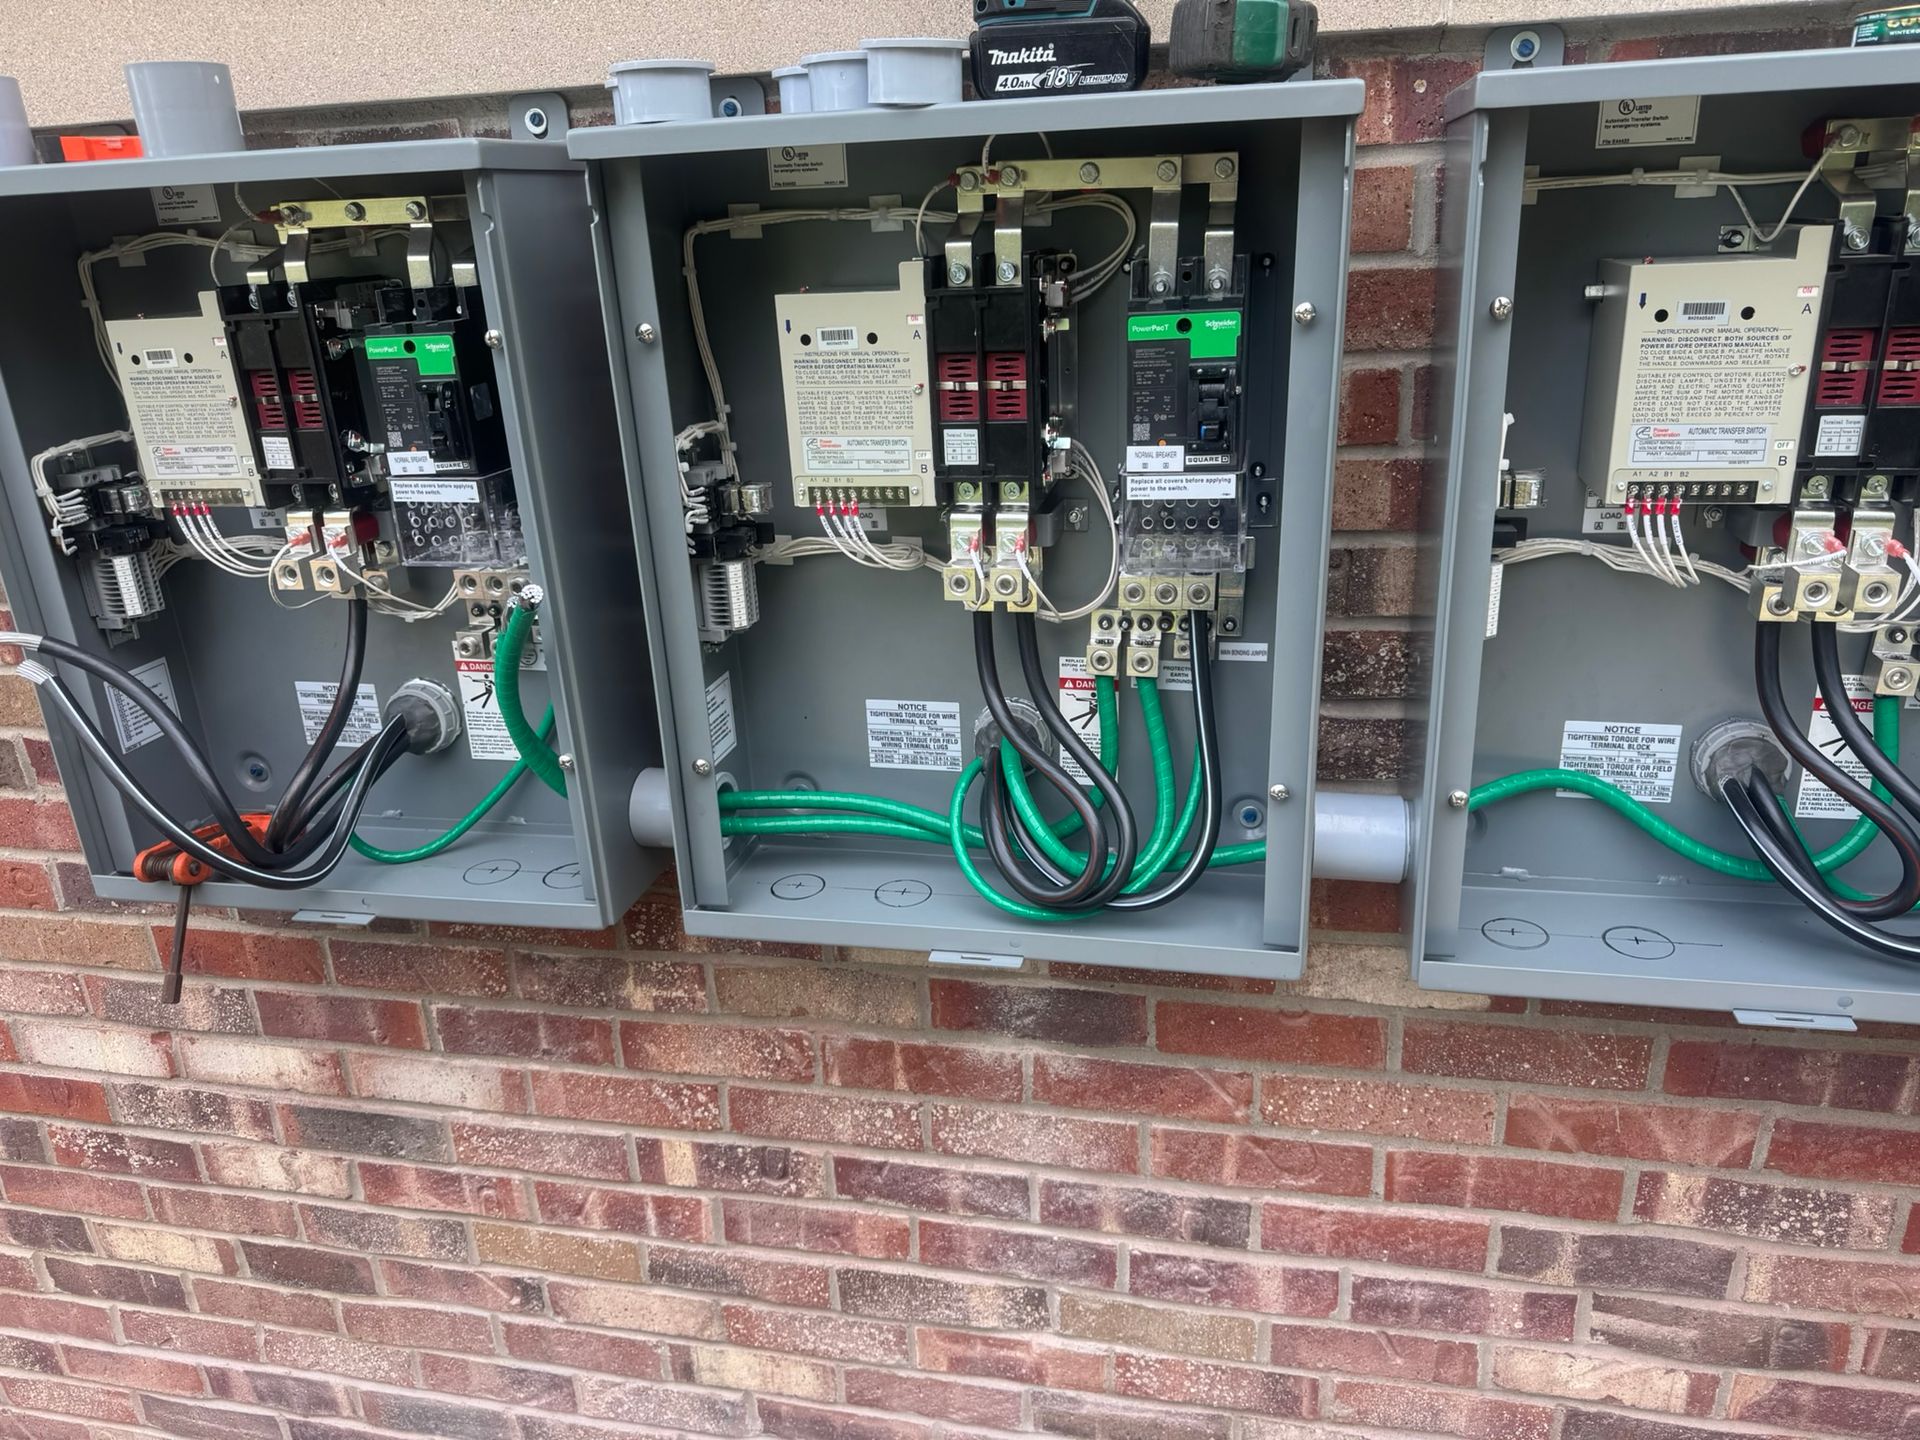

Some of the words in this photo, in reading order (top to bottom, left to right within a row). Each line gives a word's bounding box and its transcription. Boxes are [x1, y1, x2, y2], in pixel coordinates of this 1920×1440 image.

[1000, 77, 1030, 89] 4.0Ah
[1079, 73, 1128, 86] LITHIUM-ION
[1801, 303, 1812, 314] A
[1205, 319, 1237, 330] Schneider
[912, 329, 921, 340] A
[220, 350, 228, 359] A
[1688, 427, 1717, 435] AUTOMATIC
[1746, 426, 1767, 434] SWITCH
[1778, 455, 1787, 466] B
[248, 468, 255, 476] B
[920, 464, 928, 473] B
[897, 703, 927, 711] NOTICE
[1604, 725, 1641, 734] NOTICE
[871, 735, 904, 743] TIGHTENING
[1611, 735, 1639, 743] TORQUE
[1590, 742, 1625, 750] TERMINAL
[1563, 761, 1605, 769] TIGHTENING
[1603, 770, 1637, 778] TERMINAL
